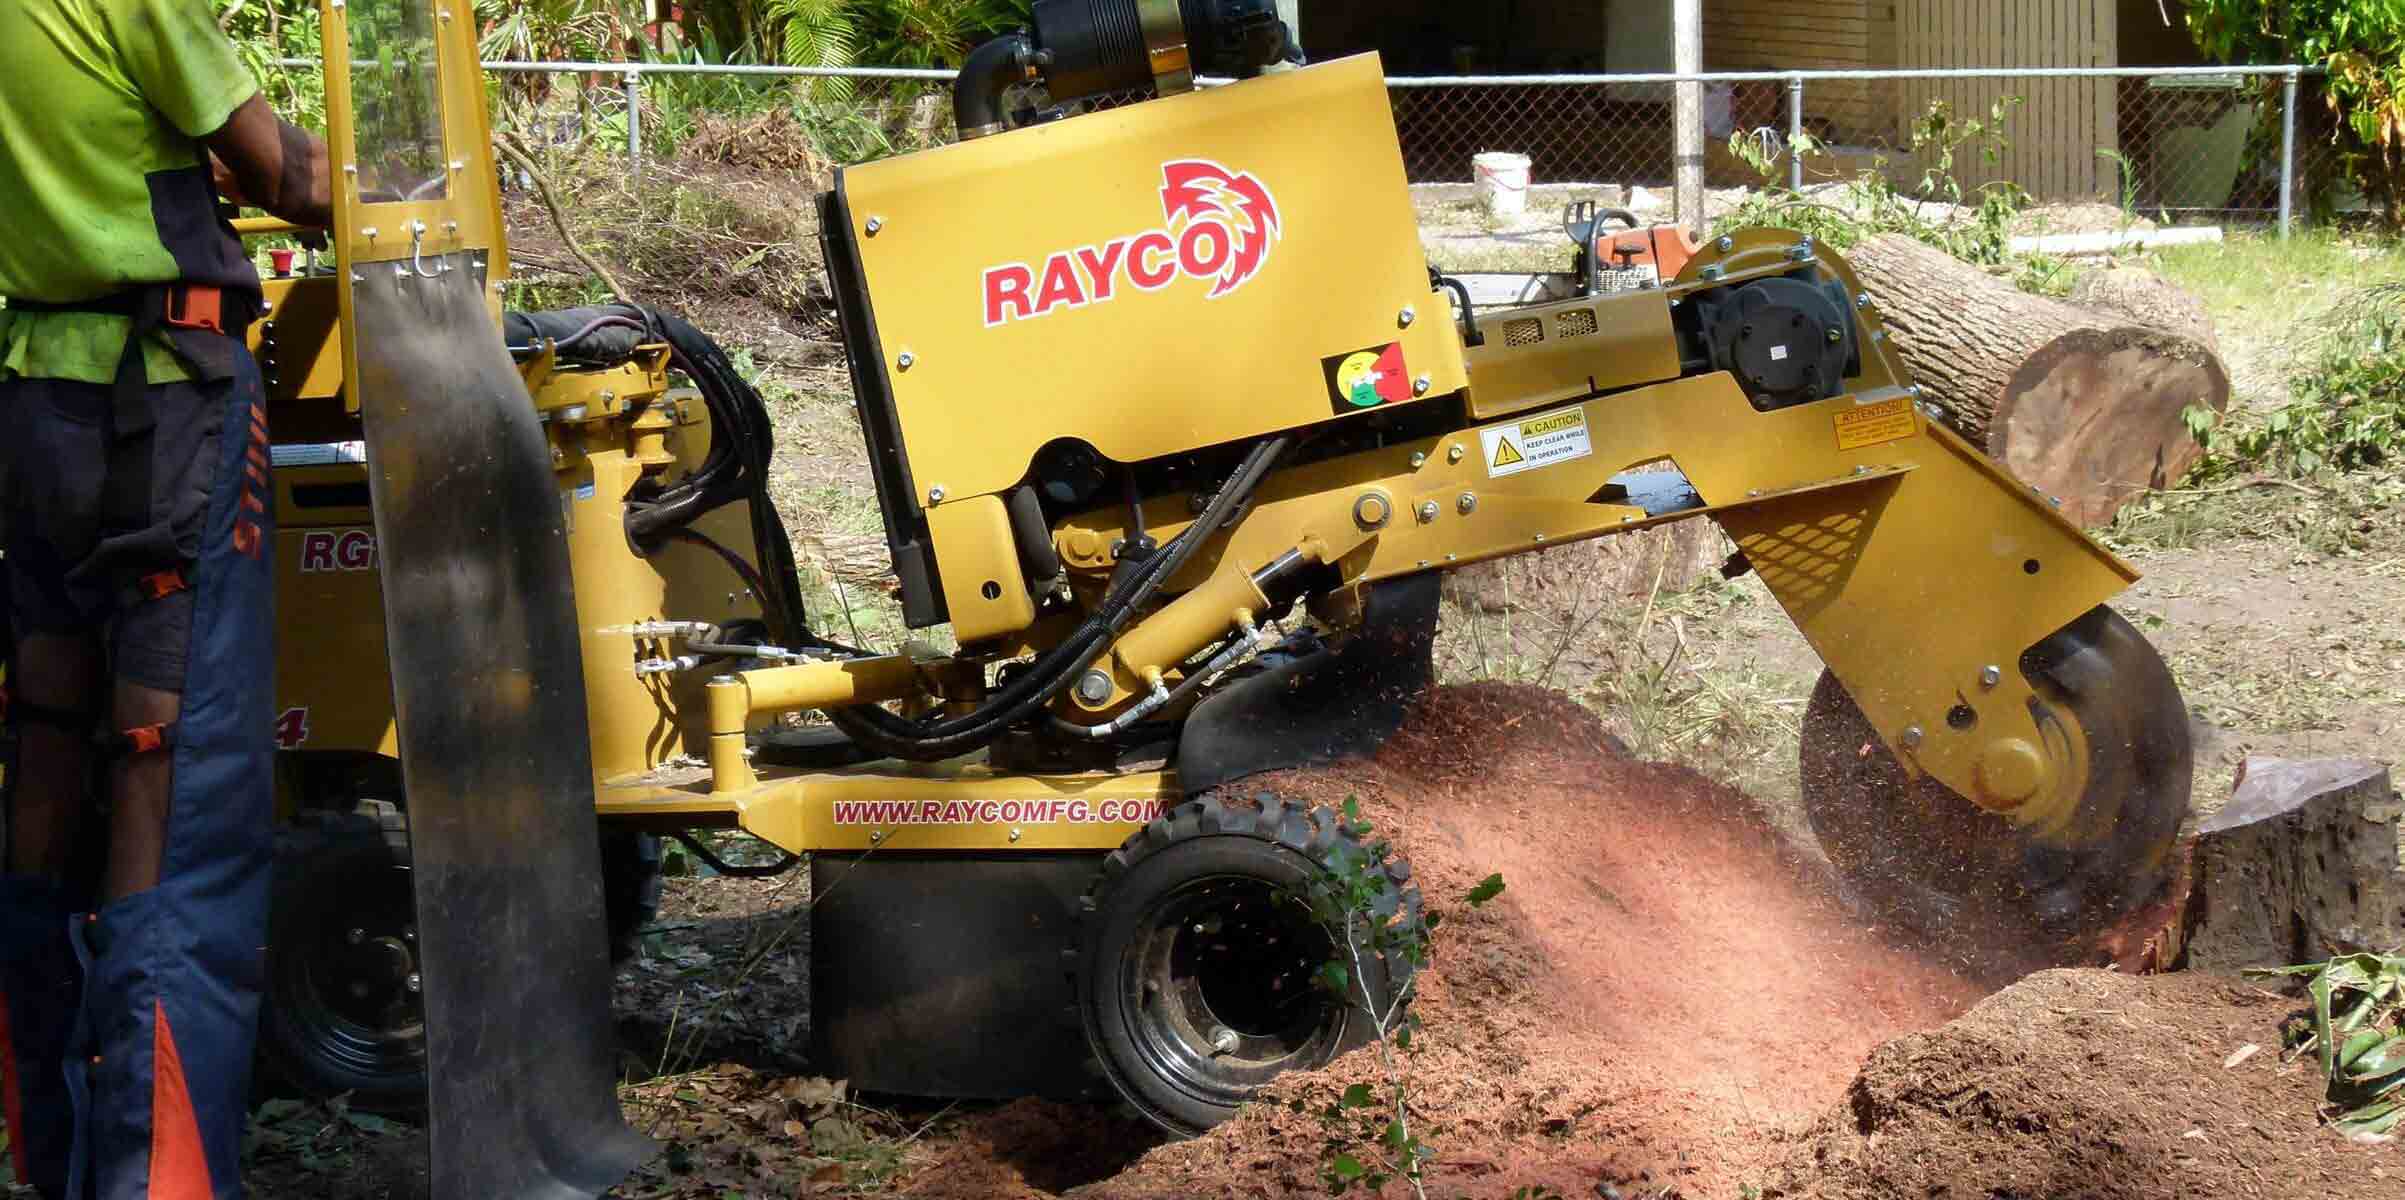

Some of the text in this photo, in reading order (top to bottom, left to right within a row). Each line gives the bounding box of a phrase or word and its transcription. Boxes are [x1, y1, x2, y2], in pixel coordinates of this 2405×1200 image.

[984, 218, 1231, 327] RAYCO
[1534, 413, 1581, 432] CAUTION
[1526, 429, 1585, 449] KEEP CLEAR WHILE
[1537, 445, 1574, 459] OPERATION
[301, 530, 376, 573] RG
[832, 800, 1169, 824] WWW.RAYCOMFG.COM
